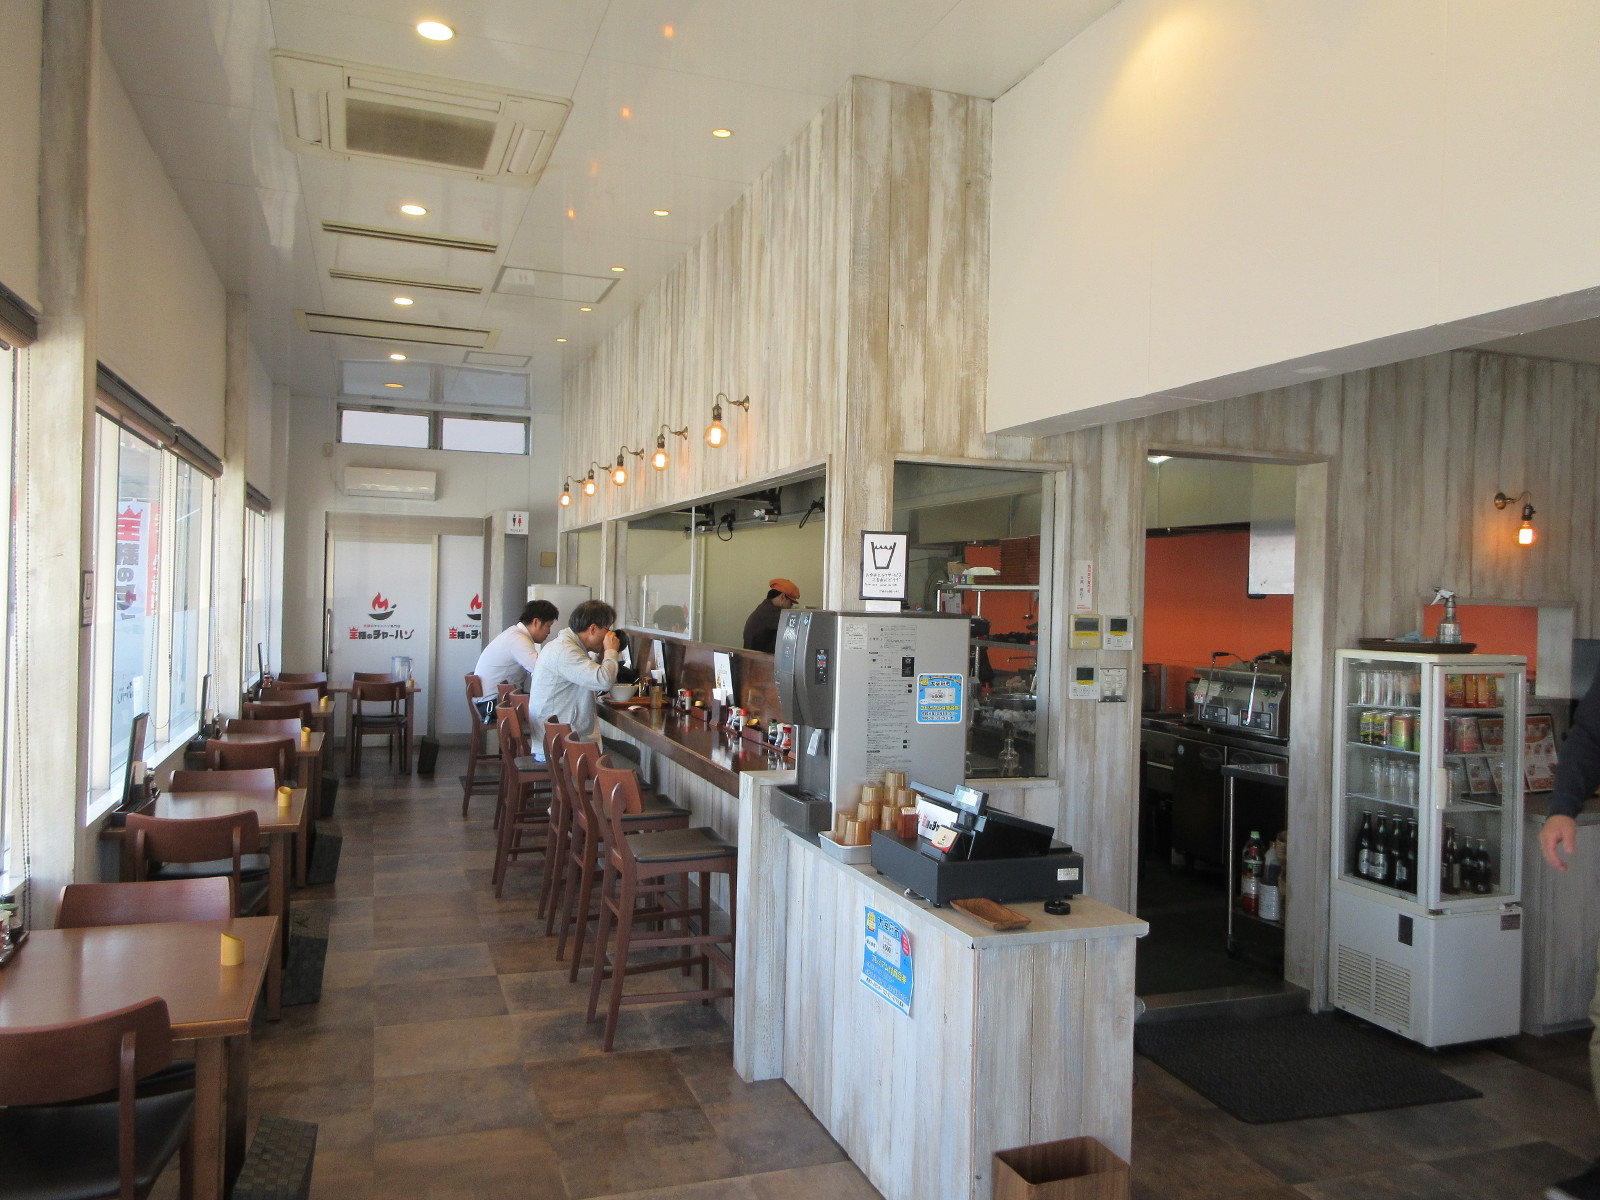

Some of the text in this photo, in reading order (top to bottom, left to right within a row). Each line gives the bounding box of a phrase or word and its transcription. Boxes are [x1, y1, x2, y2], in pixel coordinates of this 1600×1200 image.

[349, 626, 415, 640] 王様のチャーハン
